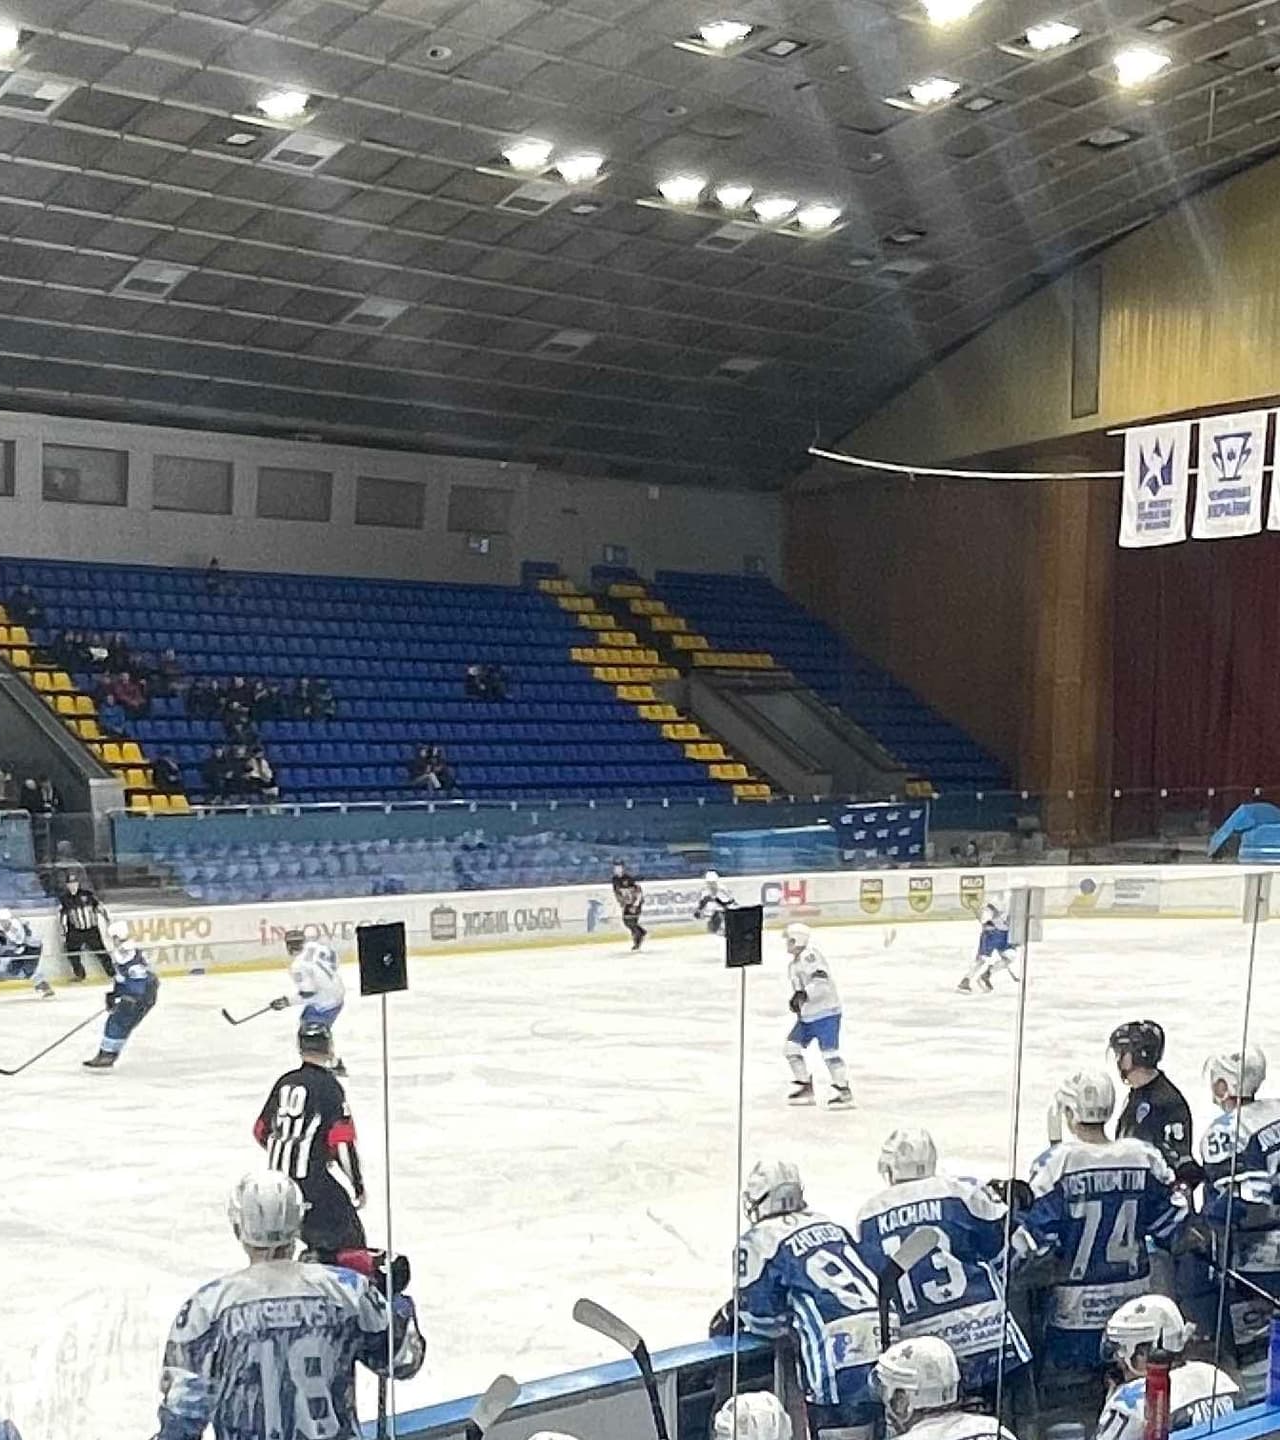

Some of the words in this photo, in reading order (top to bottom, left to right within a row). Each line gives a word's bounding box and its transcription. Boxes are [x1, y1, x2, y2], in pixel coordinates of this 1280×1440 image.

[278, 1084, 308, 1118] 10
[878, 1200, 943, 1235] KACHAN
[1070, 1199, 1139, 1281] 74
